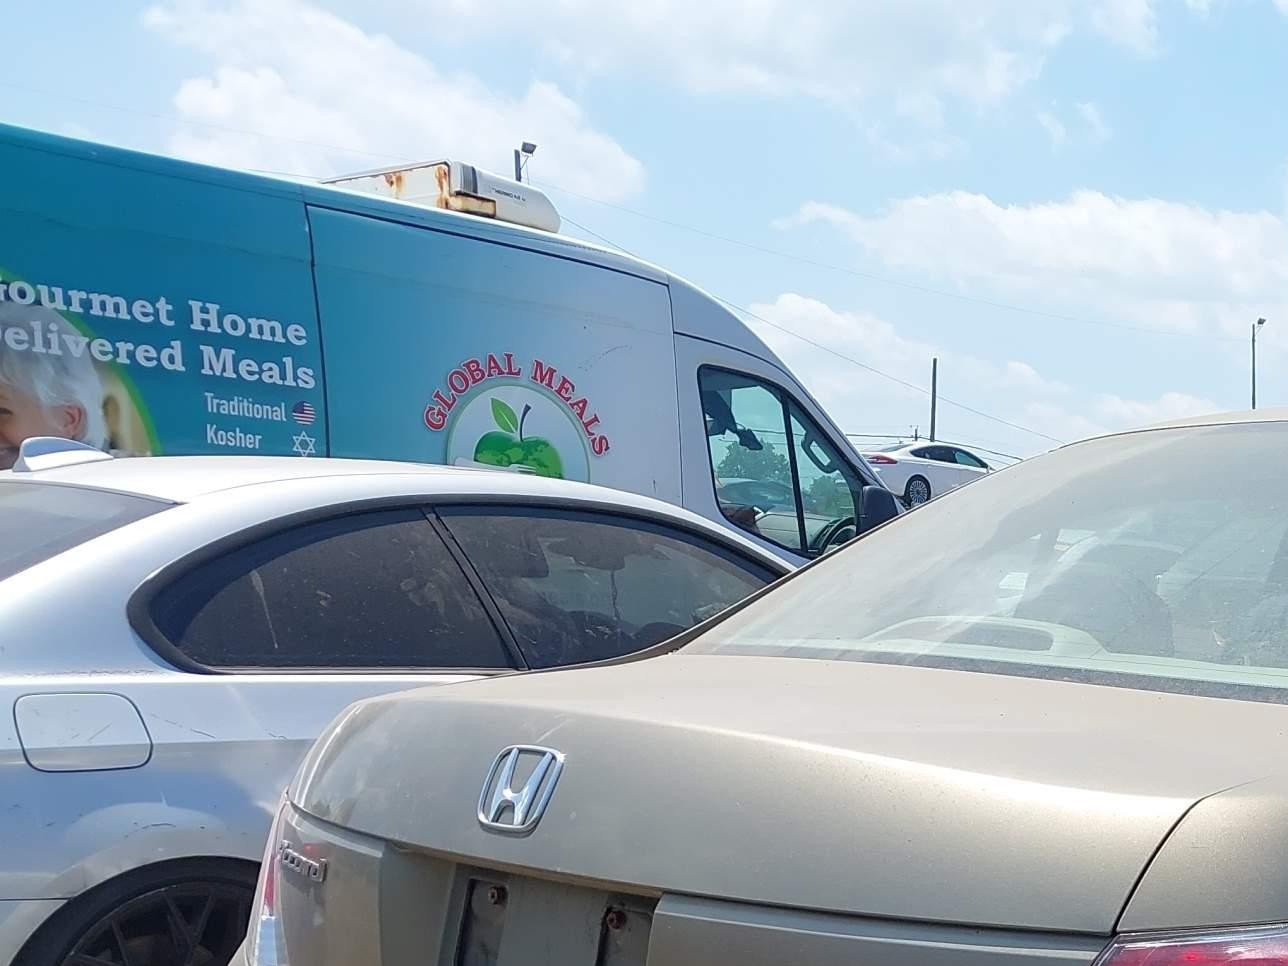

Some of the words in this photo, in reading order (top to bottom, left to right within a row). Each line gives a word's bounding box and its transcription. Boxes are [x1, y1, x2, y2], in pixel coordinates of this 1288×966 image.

[188, 299, 308, 346] Home
[0, 320, 186, 373] elivered
[199, 344, 316, 389] Meals
[204, 392, 287, 422] Traditional
[424, 352, 522, 431] GLOBAL
[530, 359, 611, 457] MEALS
[206, 423, 262, 449] Kosher
